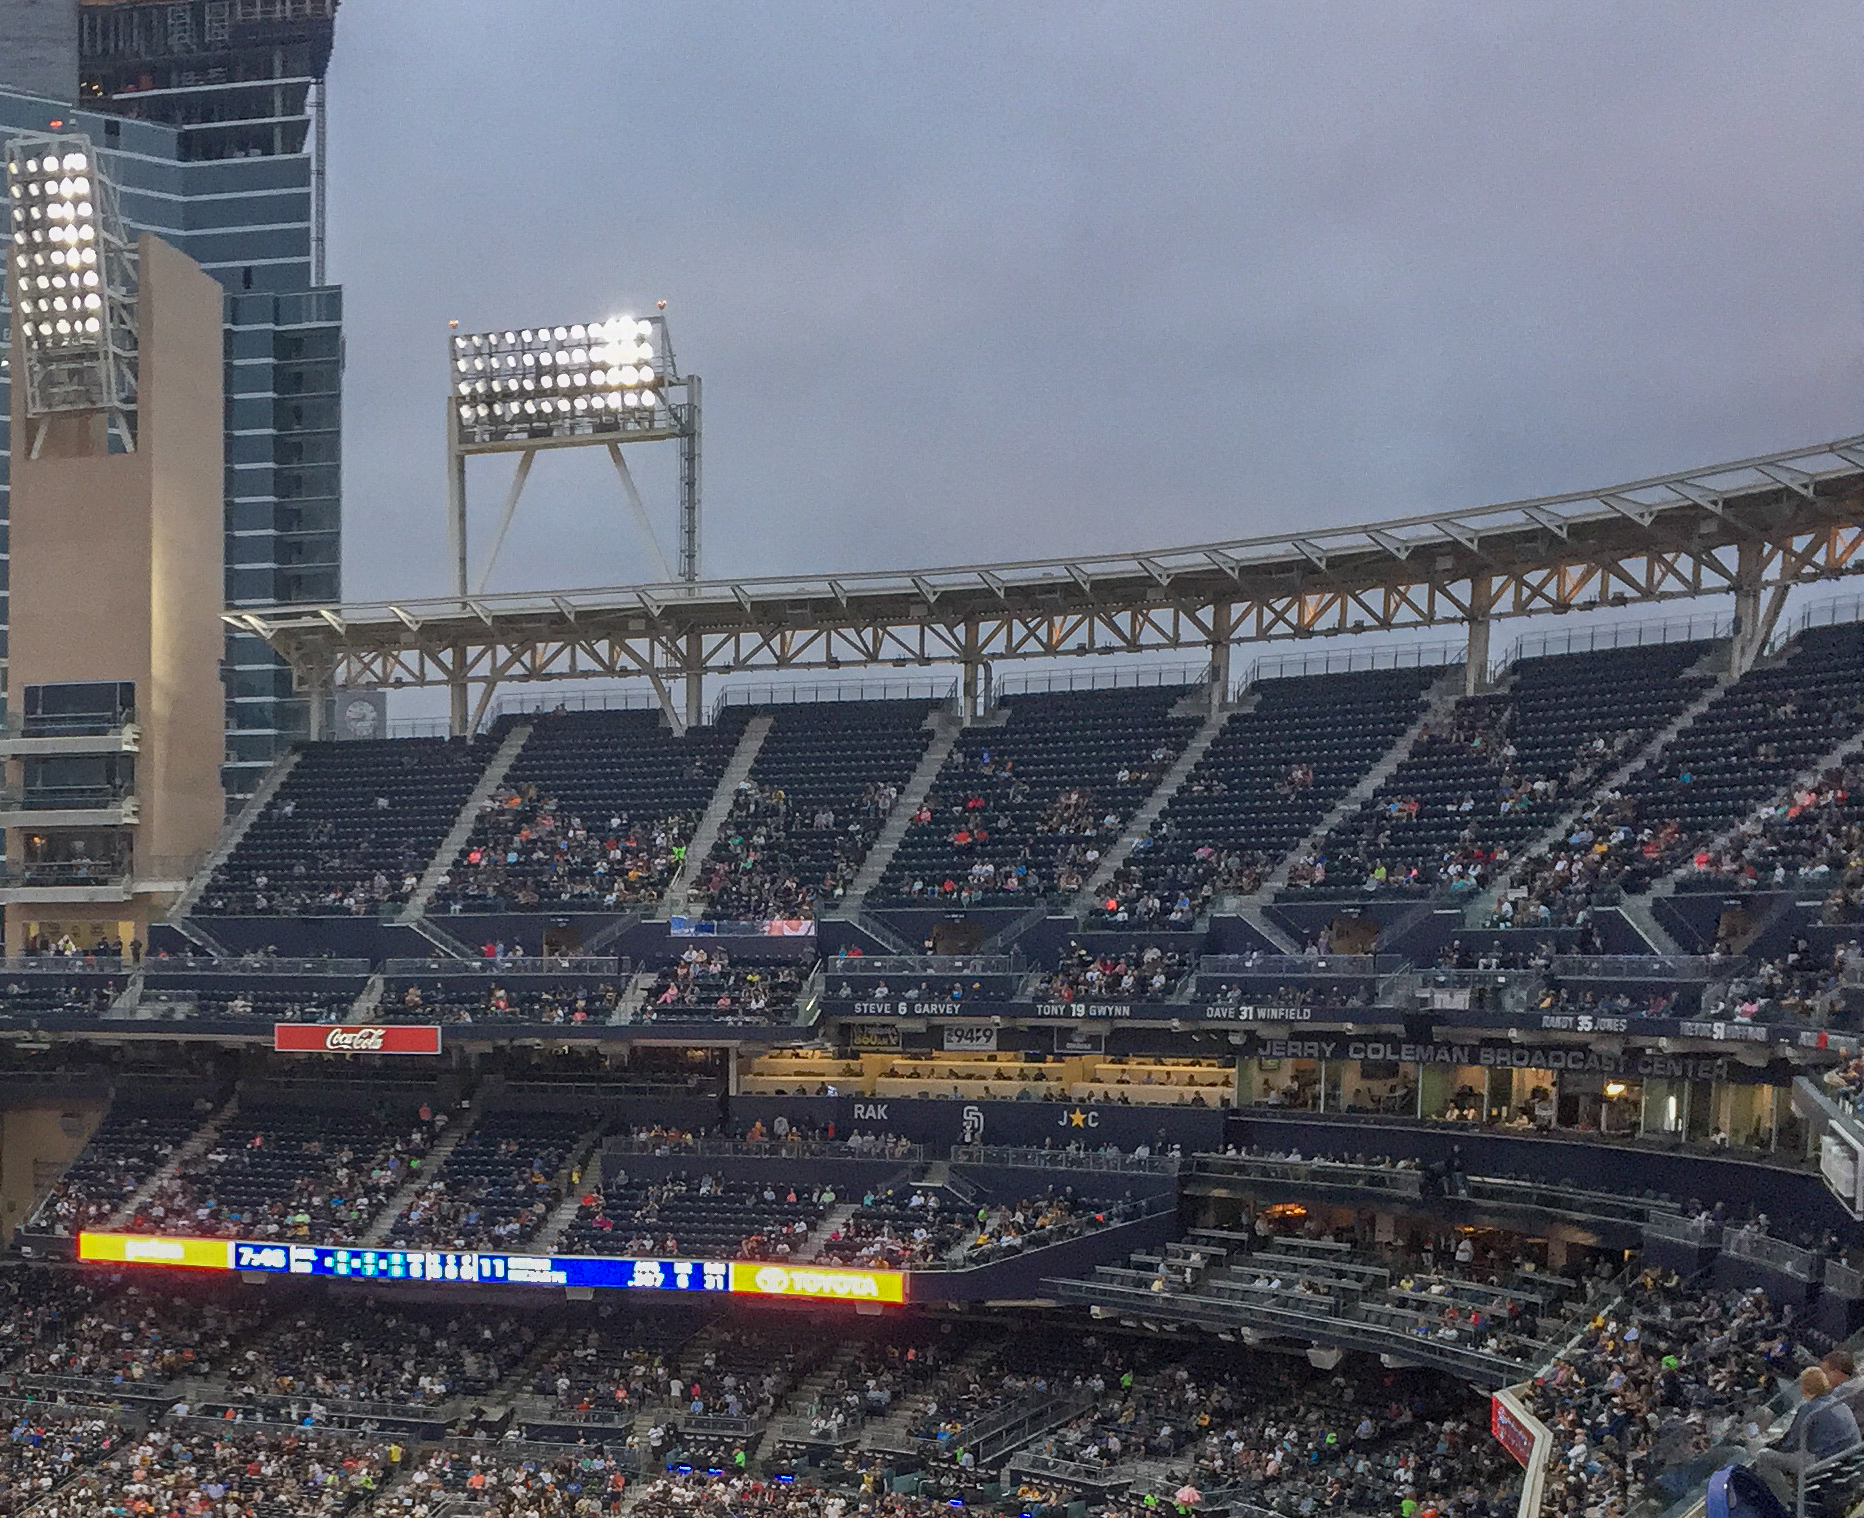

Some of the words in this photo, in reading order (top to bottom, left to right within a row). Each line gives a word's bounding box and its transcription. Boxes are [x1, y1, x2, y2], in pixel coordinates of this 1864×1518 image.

[854, 1003, 891, 1015] STEVE
[898, 1002, 907, 1015] 6
[914, 1003, 961, 1015] GARVEY
[1036, 1004, 1066, 1017] TONY
[1070, 1002, 1085, 1017] 19
[1089, 1005, 1130, 1017] GWYNN
[1206, 1007, 1235, 1019] DAVE
[1239, 1006, 1253, 1020] 31
[1257, 1007, 1311, 1020] WINFIELD
[1258, 1041, 1337, 1058] JERRY
[1349, 1042, 1469, 1064] COLEMAN
[1480, 1048, 1626, 1074] BROADCAST
[1637, 1057, 1729, 1080] CENTER
[854, 1104, 888, 1120] RAK
[480, 1257, 505, 1277] 11
[790, 1272, 878, 1297] TOYOTA
